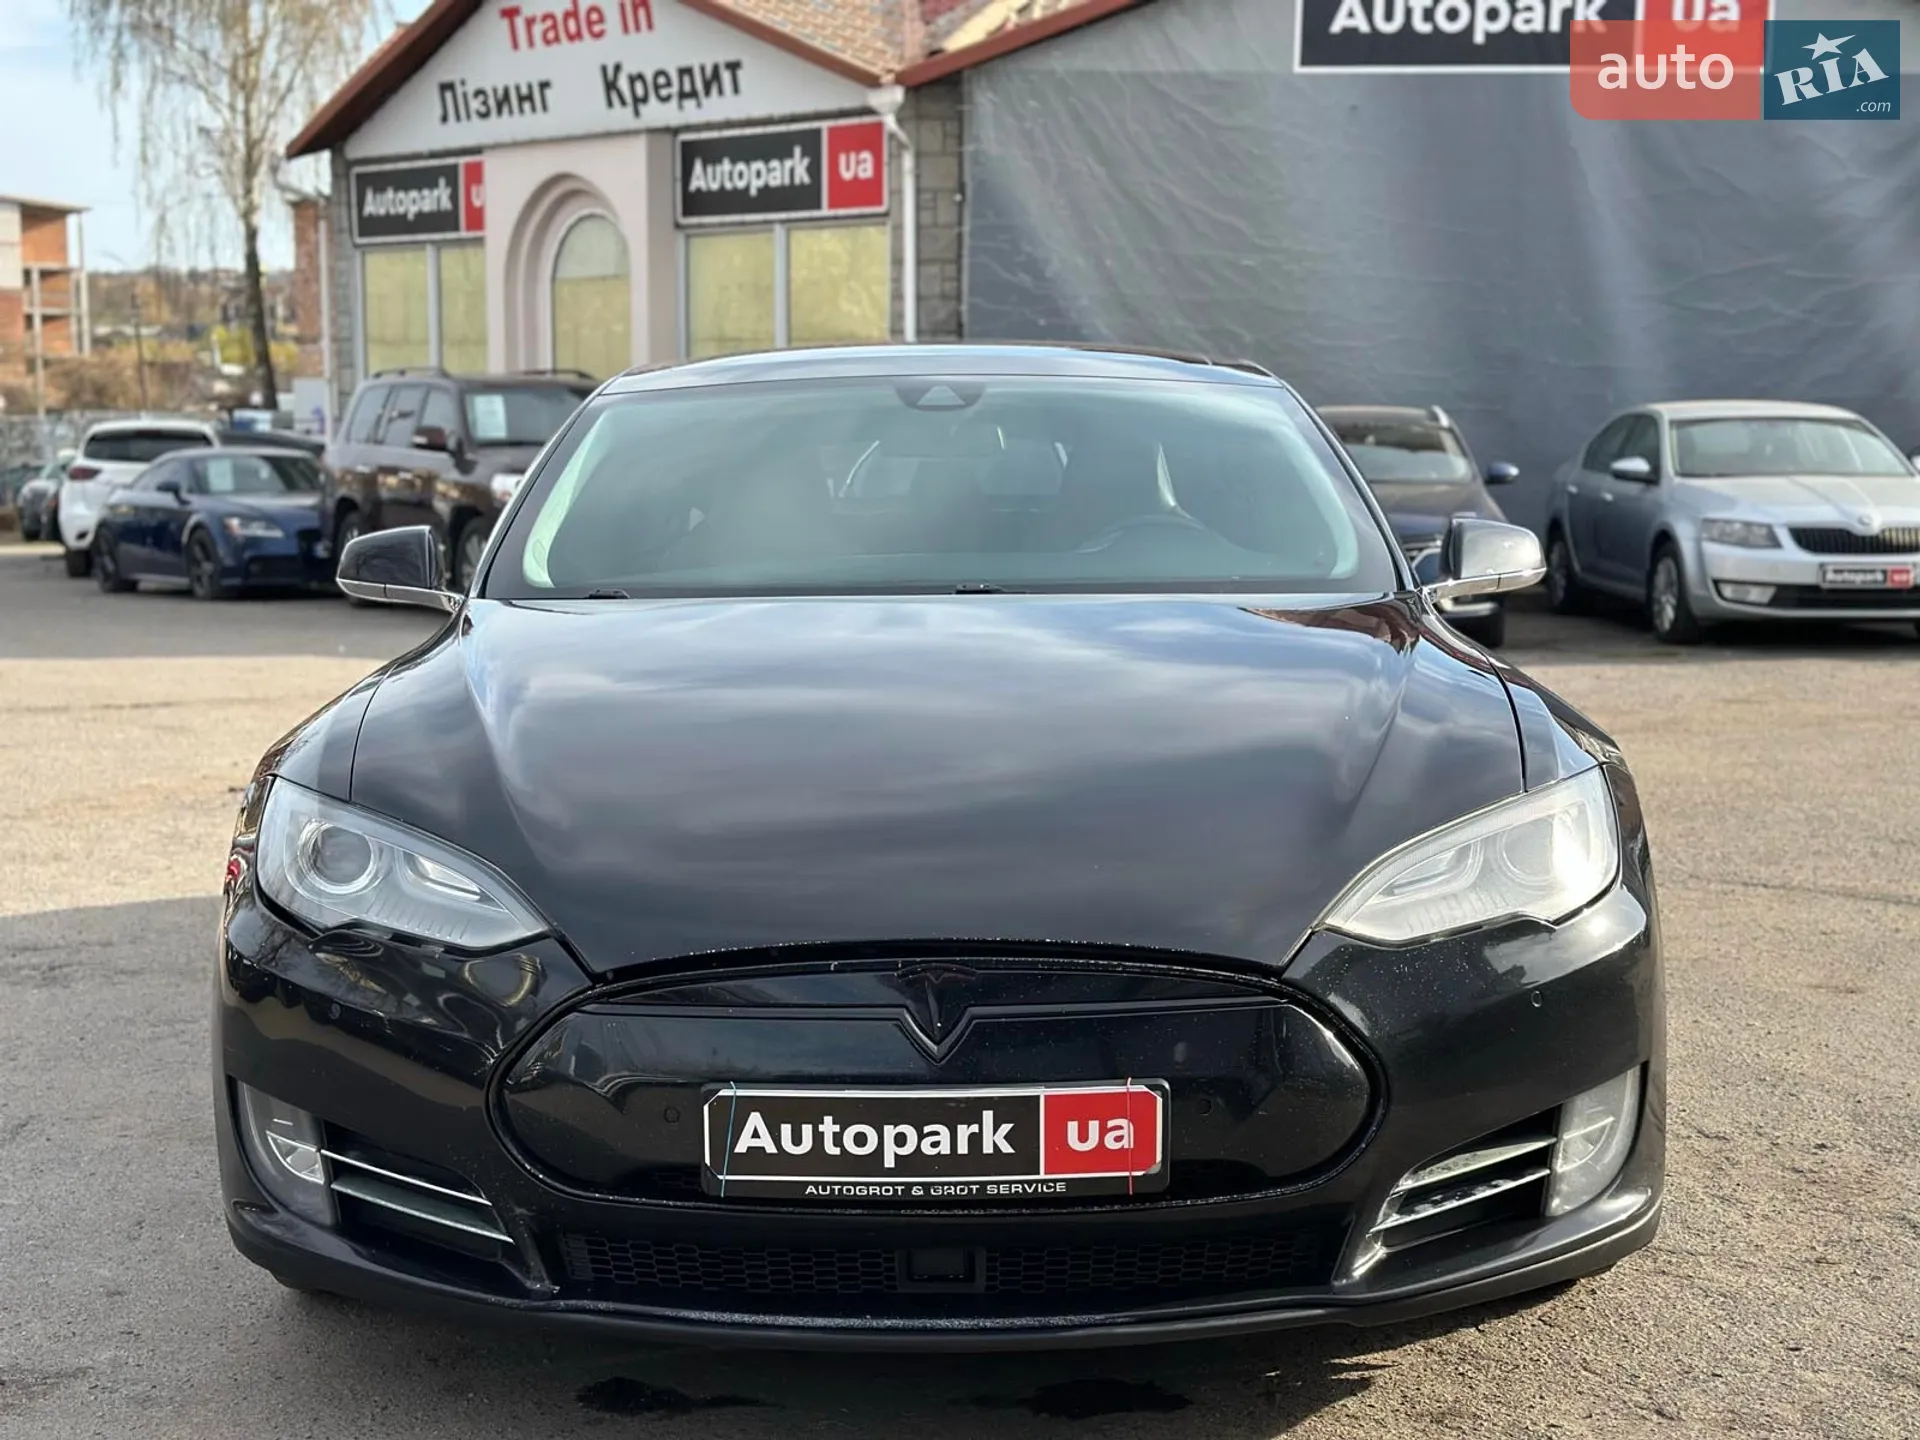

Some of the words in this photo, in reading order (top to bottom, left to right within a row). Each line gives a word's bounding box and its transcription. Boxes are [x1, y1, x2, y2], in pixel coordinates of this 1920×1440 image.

[499, 0, 607, 52] Trade
[618, 0, 654, 35] in
[1329, 0, 1607, 45] Autopark
[1671, 0, 1741, 34] ua
[438, 78, 552, 125] Лізинг
[600, 59, 743, 118] Кредит
[688, 146, 811, 197] Autopark
[838, 149, 874, 182] ua
[362, 176, 453, 221] Autopark
[733, 1110, 1015, 1168] Autopark
[1066, 1117, 1135, 1151] ua
[805, 1185, 905, 1196] AUTOGROT
[911, 1186, 924, 1196] &
[930, 1185, 980, 1196] GROT
[986, 1182, 1067, 1194] SERVICE
